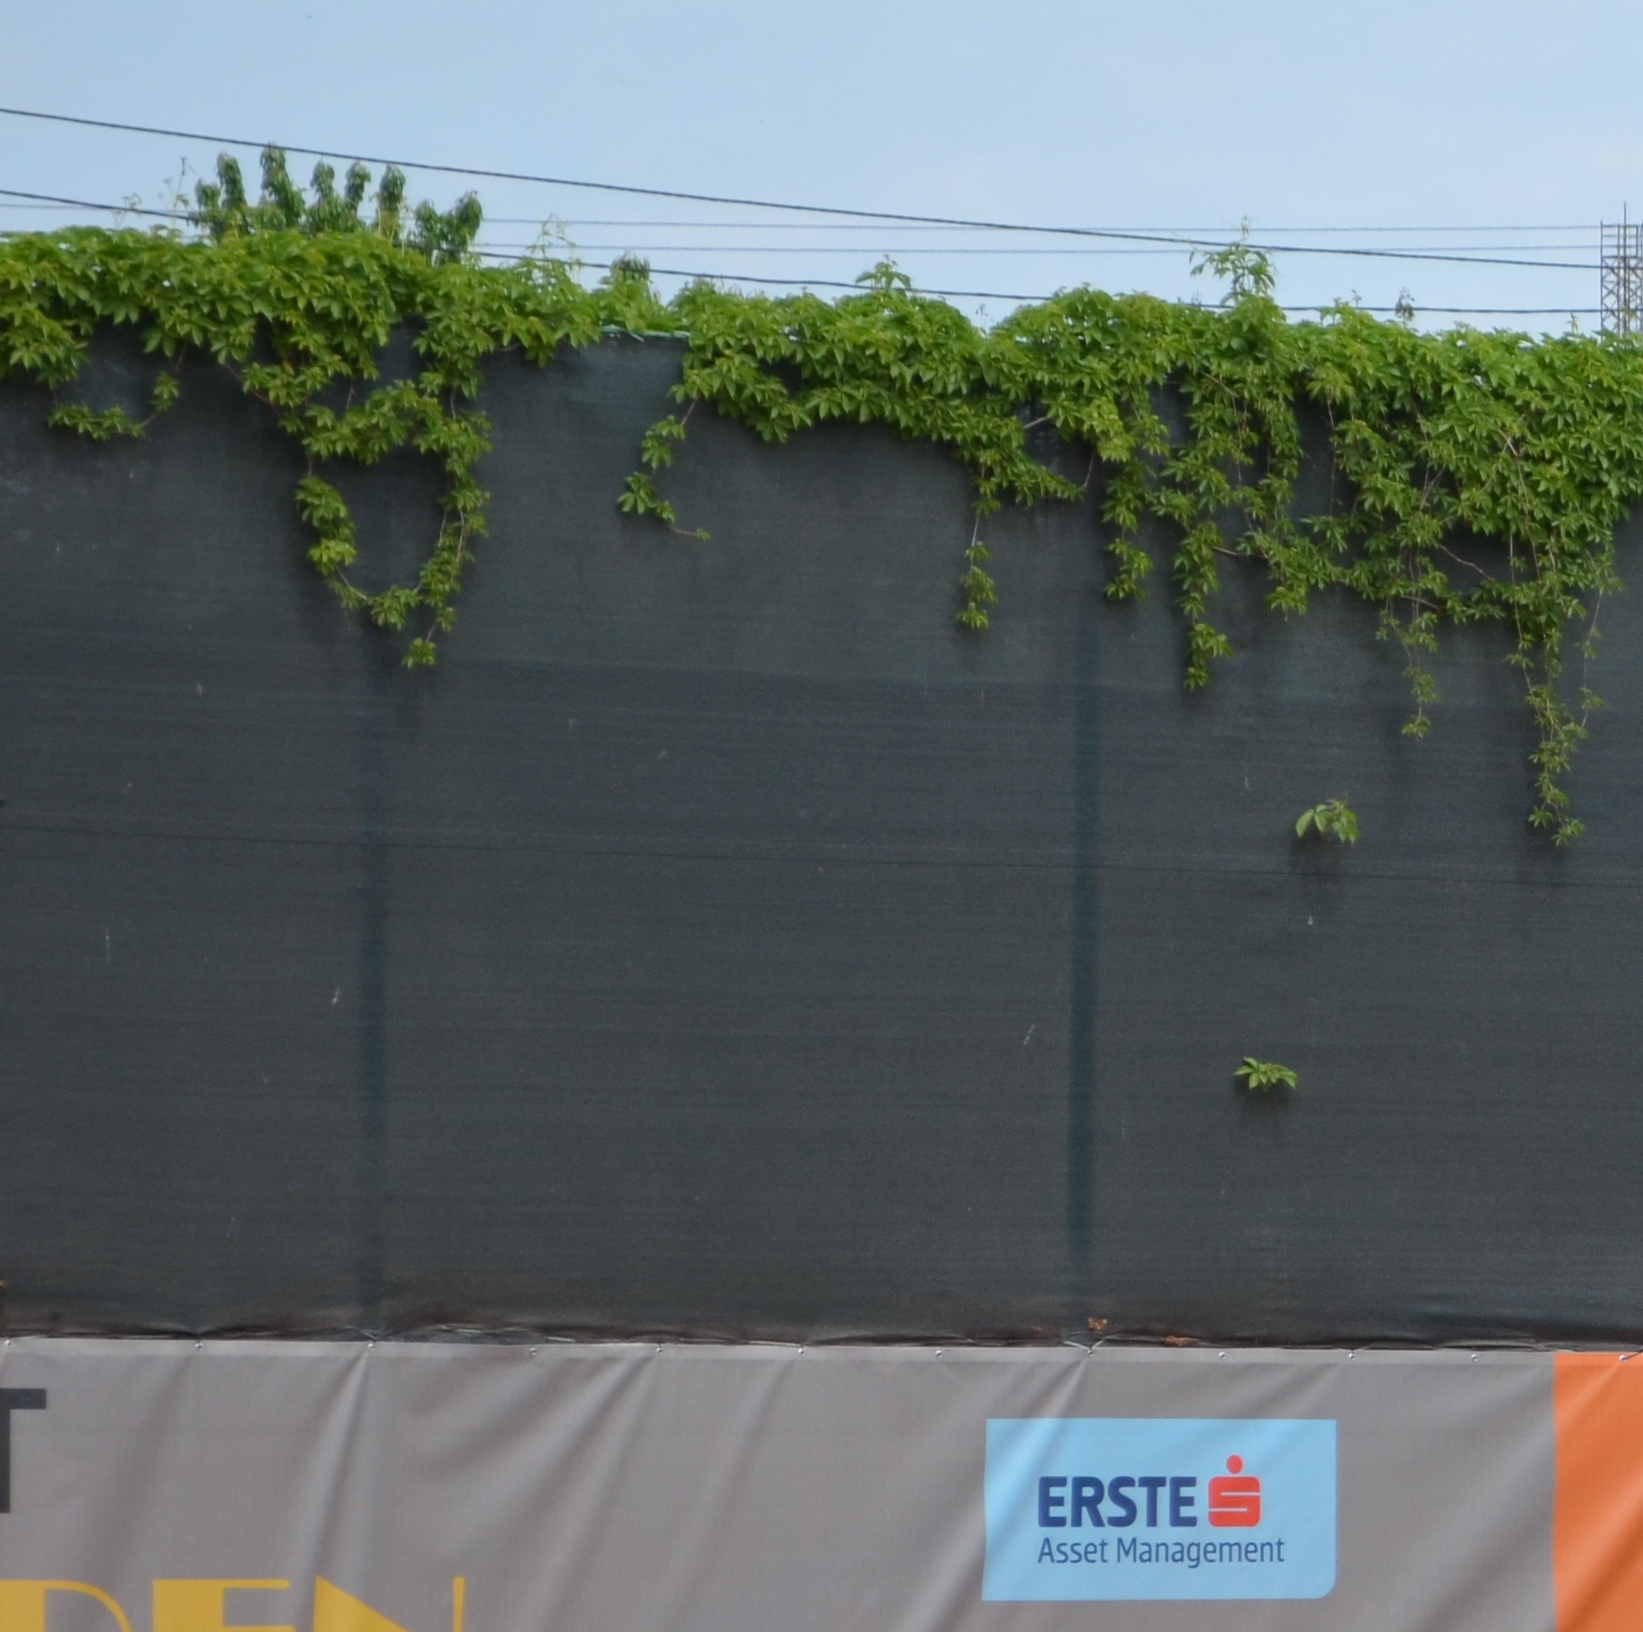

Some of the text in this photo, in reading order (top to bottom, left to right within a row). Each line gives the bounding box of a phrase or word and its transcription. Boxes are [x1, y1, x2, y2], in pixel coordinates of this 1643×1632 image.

[1037, 1475, 1198, 1528] ERSTE
[1037, 1537, 1285, 1568] Asset Management
